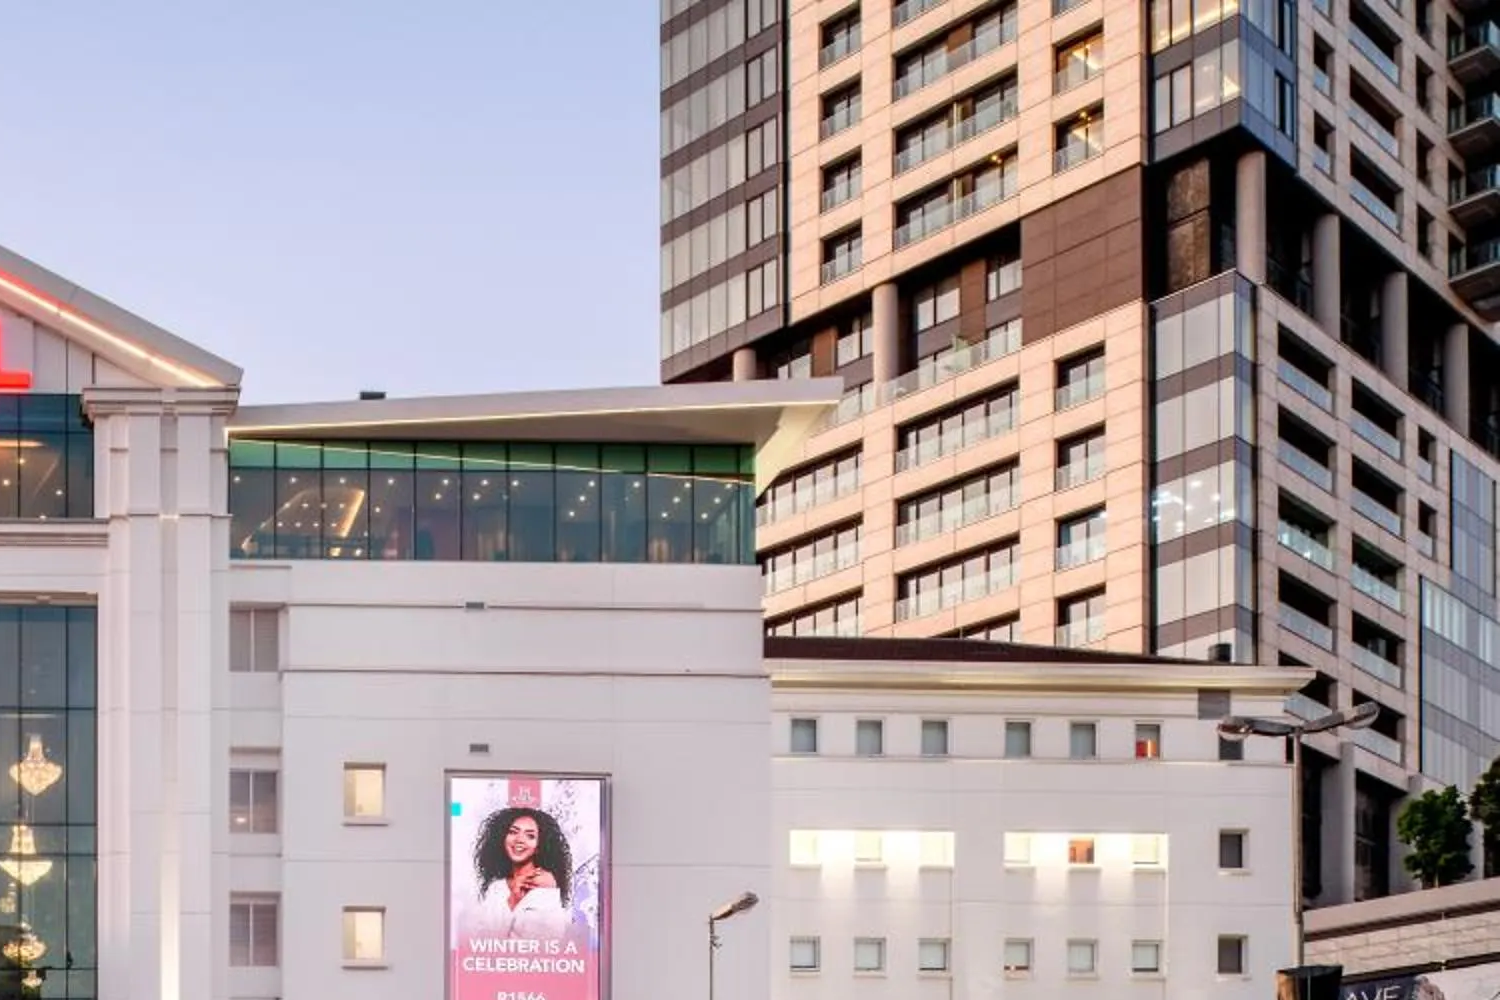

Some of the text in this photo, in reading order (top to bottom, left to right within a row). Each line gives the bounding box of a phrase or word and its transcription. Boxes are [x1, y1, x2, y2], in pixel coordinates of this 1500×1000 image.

[469, 938, 578, 955] WINTER IS A
[463, 957, 585, 973] CELEBRATION
